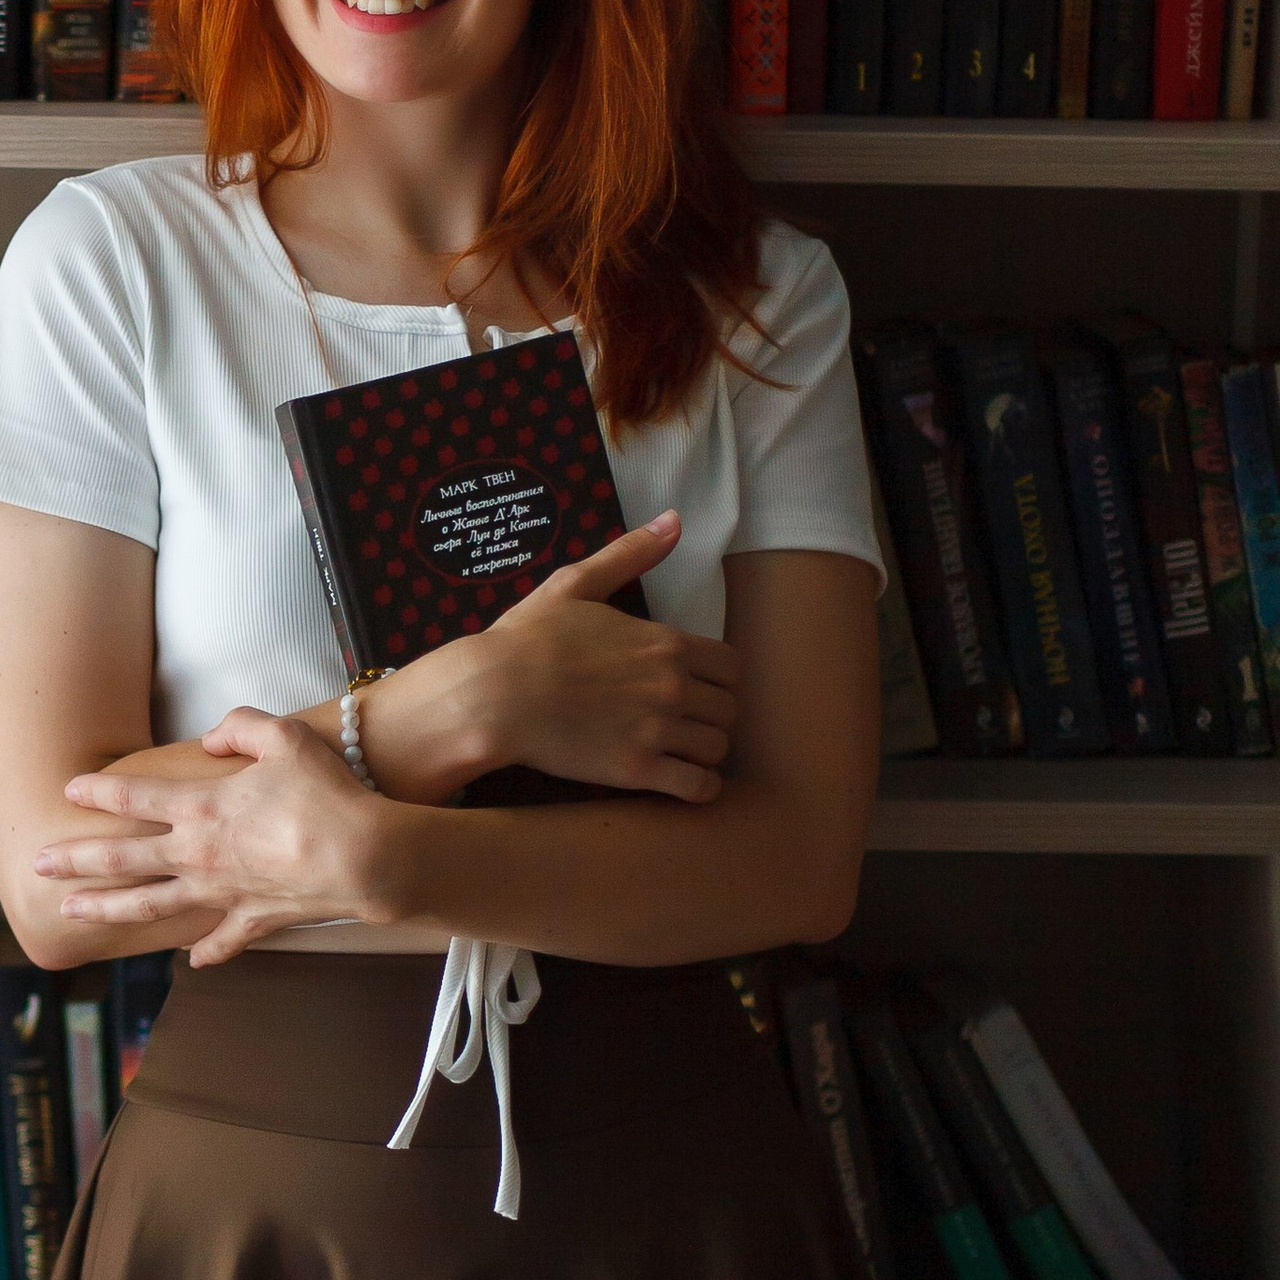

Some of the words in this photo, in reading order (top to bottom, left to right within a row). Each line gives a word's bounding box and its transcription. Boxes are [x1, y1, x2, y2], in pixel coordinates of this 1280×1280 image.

[439, 478, 478, 500] МАРК
[483, 469, 516, 486] ТВЕН
[420, 505, 463, 524] Личные
[465, 483, 545, 513] воспоминания
[452, 513, 490, 532] Жанне
[1013, 473, 1048, 565] ОХОТА
[433, 536, 462, 553] сьера
[467, 528, 491, 544] Луи
[493, 526, 507, 540] де
[485, 538, 520, 556] пажа
[472, 550, 532, 576] секретаря
